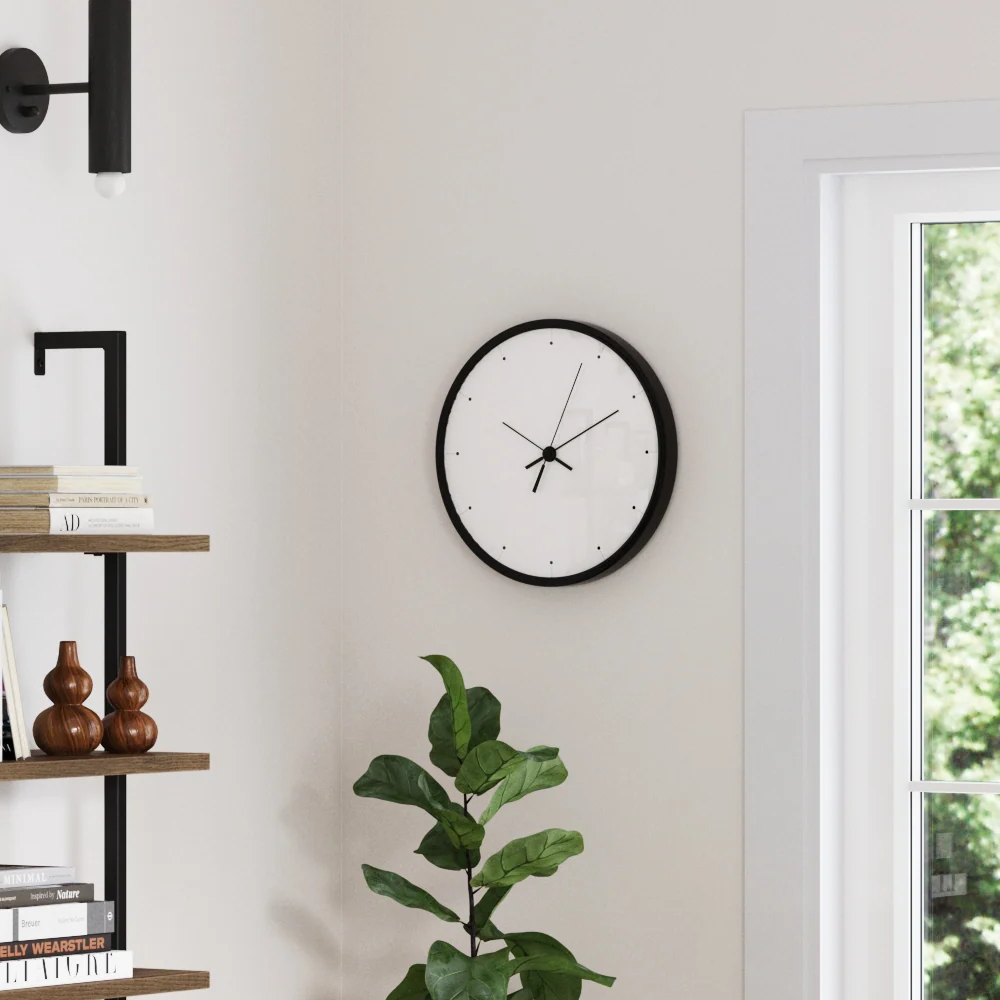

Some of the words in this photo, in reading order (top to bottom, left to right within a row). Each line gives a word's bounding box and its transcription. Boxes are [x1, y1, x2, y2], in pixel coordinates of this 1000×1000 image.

[60, 514, 80, 531] AD
[3, 872, 47, 885] MINIMAL
[56, 889, 81, 900] Nature
[21, 919, 41, 928] Breuer
[31, 936, 105, 955] WEARSTLER
